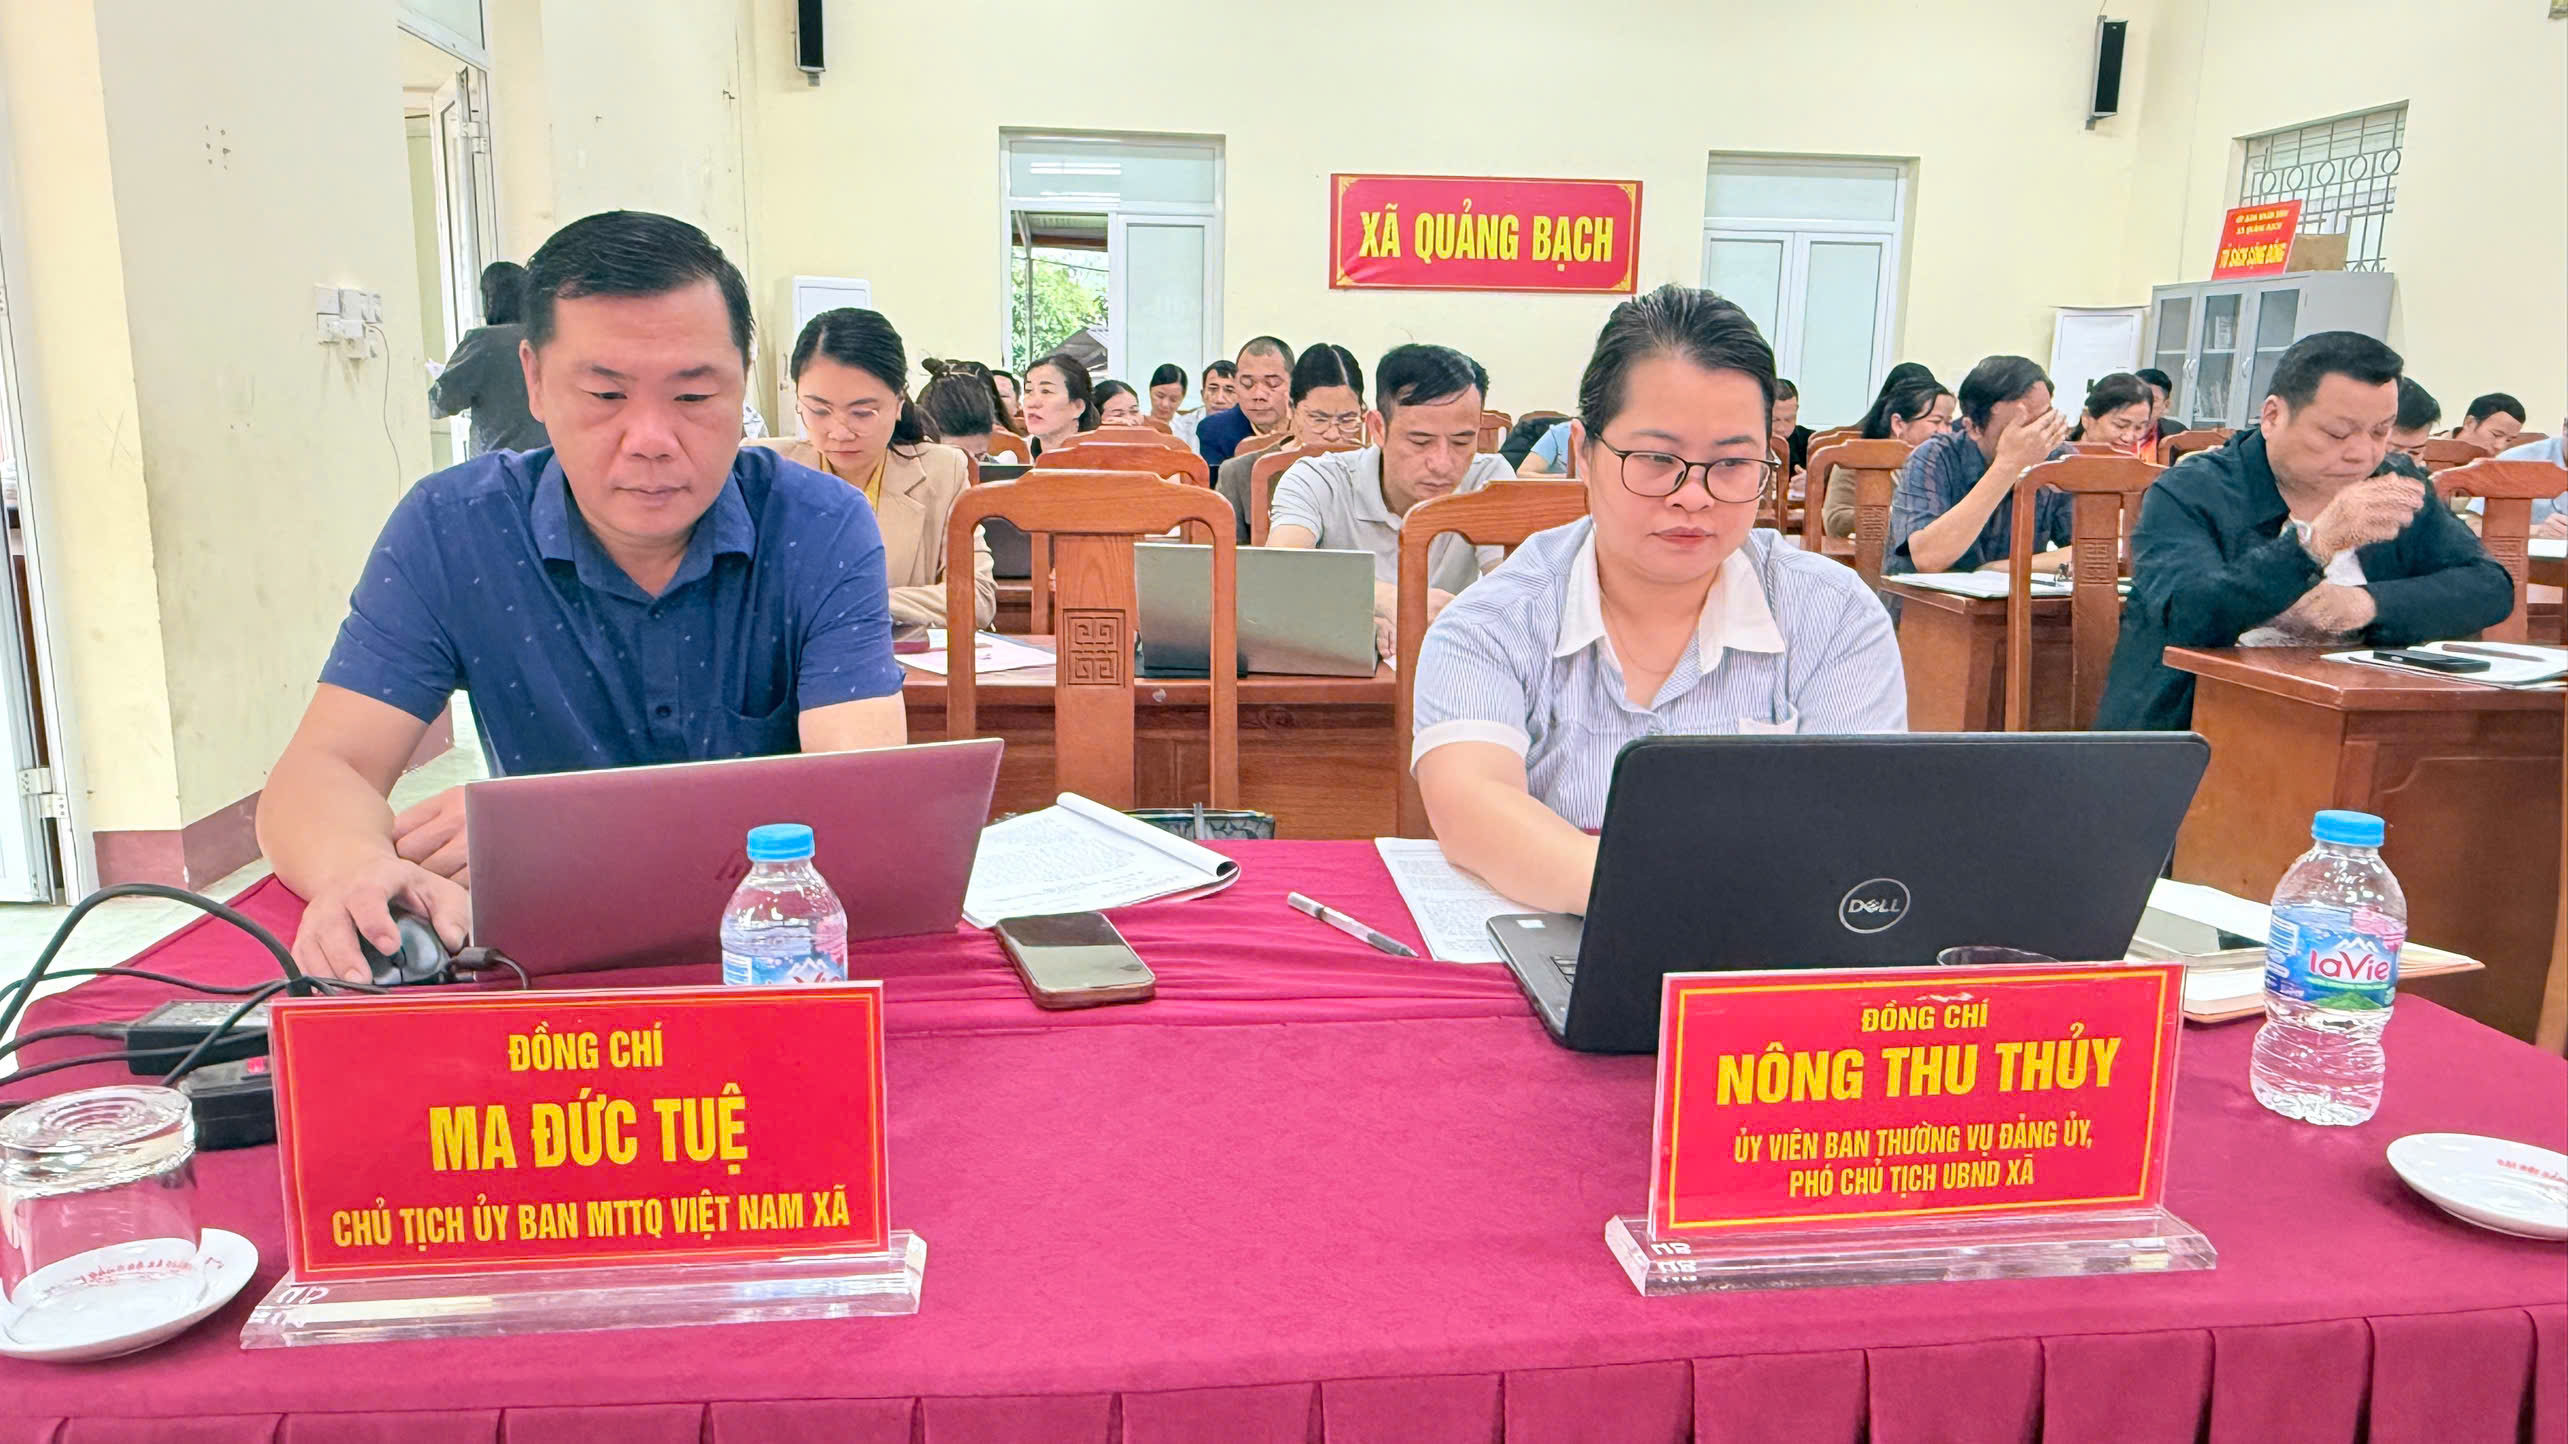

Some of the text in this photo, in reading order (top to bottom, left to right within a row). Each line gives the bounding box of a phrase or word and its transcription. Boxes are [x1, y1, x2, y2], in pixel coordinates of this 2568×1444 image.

[1359, 198, 1614, 272] XÃ QUẢNG BẠCH
[1848, 899, 1900, 913] DELL
[2309, 949, 2390, 981] laVie
[1861, 998, 1990, 1032] ĐỒNG CHÍ
[508, 1020, 664, 1072] ĐỒNG CHÍ
[1717, 1022, 2121, 1105] NÔNG THU THỦY
[429, 1083, 749, 1175] MA ĐỨC TUỆ
[1734, 1110, 2093, 1163] ỦY VIÊN BAN THƯỜNG VỤ ĐẢNG ỦY,
[1789, 1153, 2034, 1199] PHÓ CHỦ TỊCH UBND XÃ
[333, 1183, 849, 1252] CHỦ TỊCH ỦY BAN MTTQ VIỆT NAM XÃ
